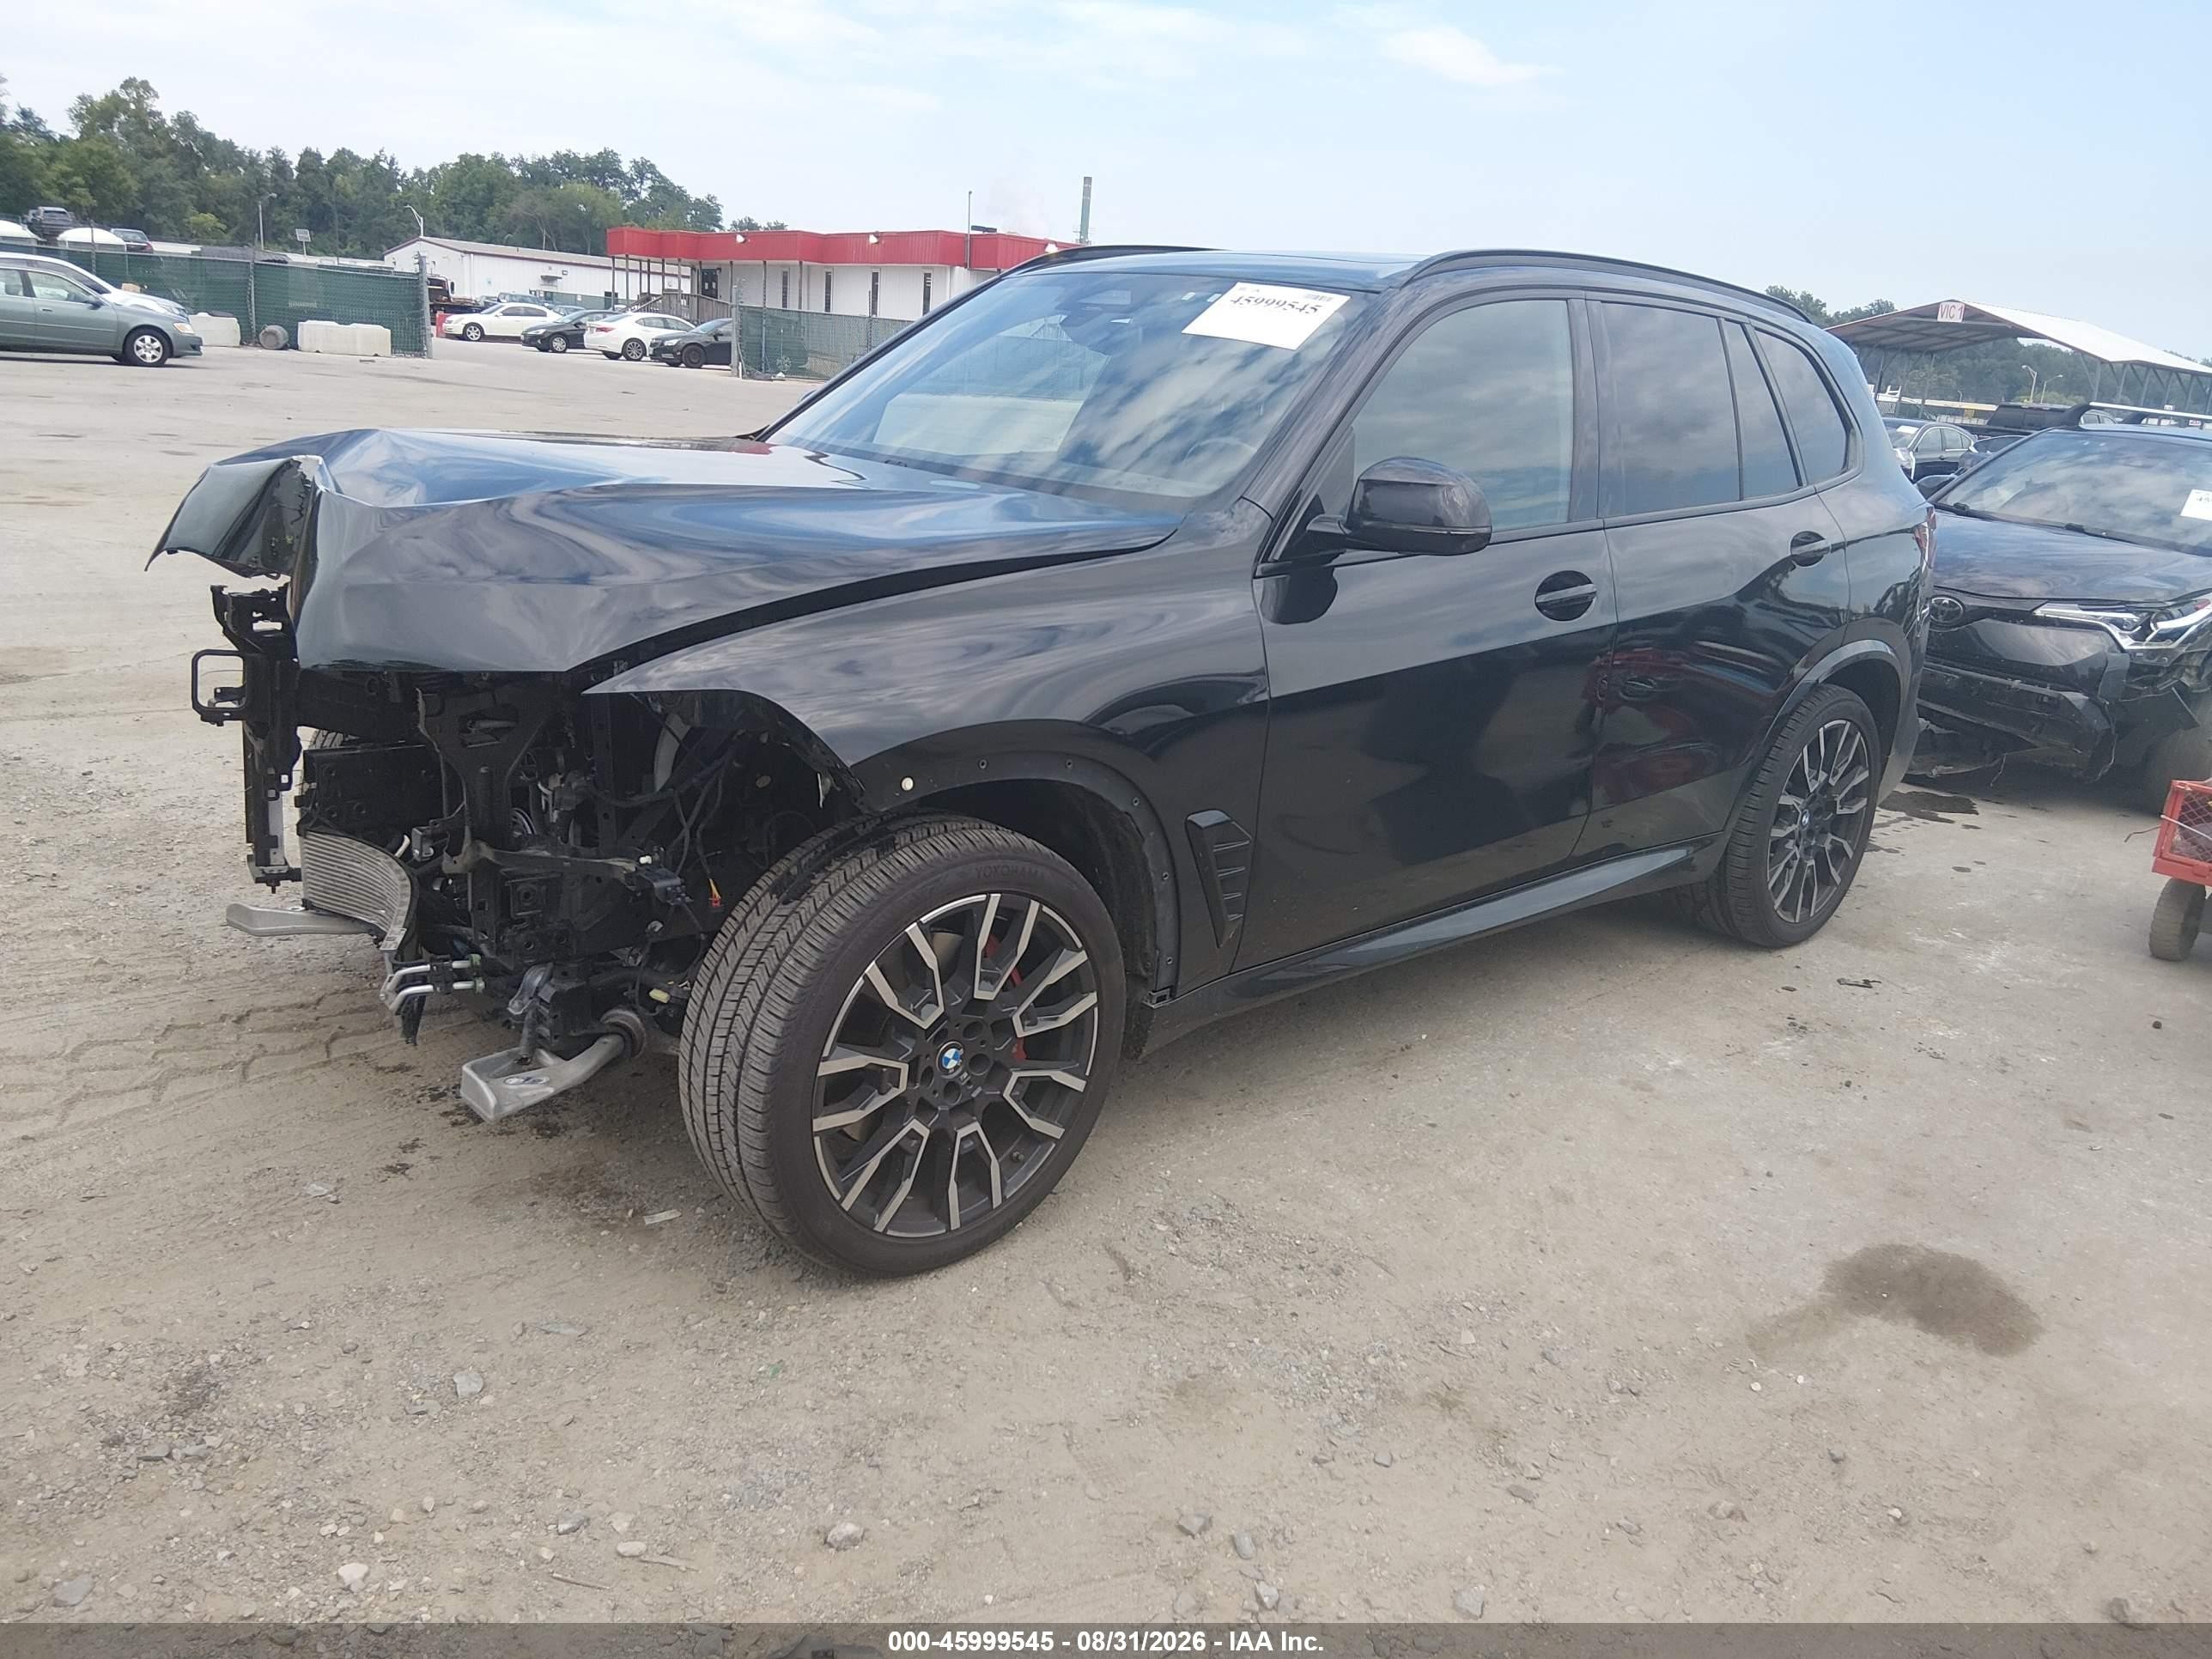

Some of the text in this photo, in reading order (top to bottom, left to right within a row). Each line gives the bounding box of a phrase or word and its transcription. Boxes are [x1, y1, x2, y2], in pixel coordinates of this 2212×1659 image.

[1231, 295, 1323, 314] 45999545
[1941, 304, 1964, 319] VIC 1
